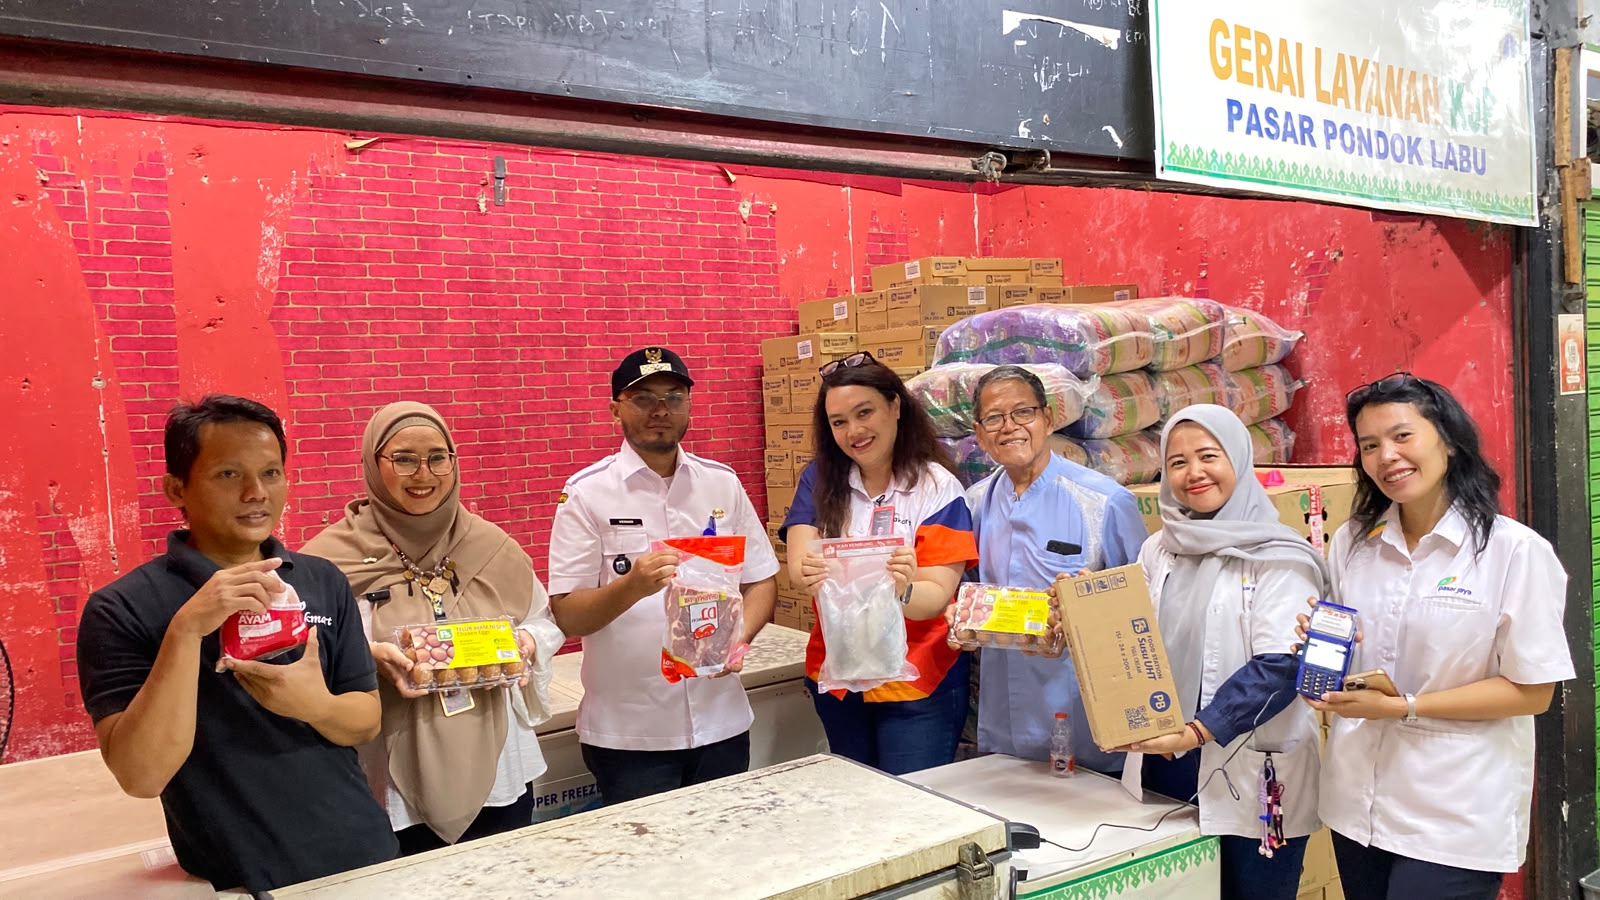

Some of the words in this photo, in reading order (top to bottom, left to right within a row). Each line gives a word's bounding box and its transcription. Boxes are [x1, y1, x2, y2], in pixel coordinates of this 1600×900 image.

[1209, 18, 1304, 98] GERAI
[1314, 47, 1440, 126] LAYANAN
[1226, 98, 1317, 148] PASAR
[1324, 119, 1424, 166] PONDOK
[1431, 139, 1486, 176] LABU
[1456, 588, 1472, 596] jaya
[238, 612, 271, 625] AYAM
[1138, 637, 1149, 660] Susu
[1144, 660, 1157, 680] UHT
[1152, 654, 1163, 679] STATION
[1154, 694, 1166, 709] PB
